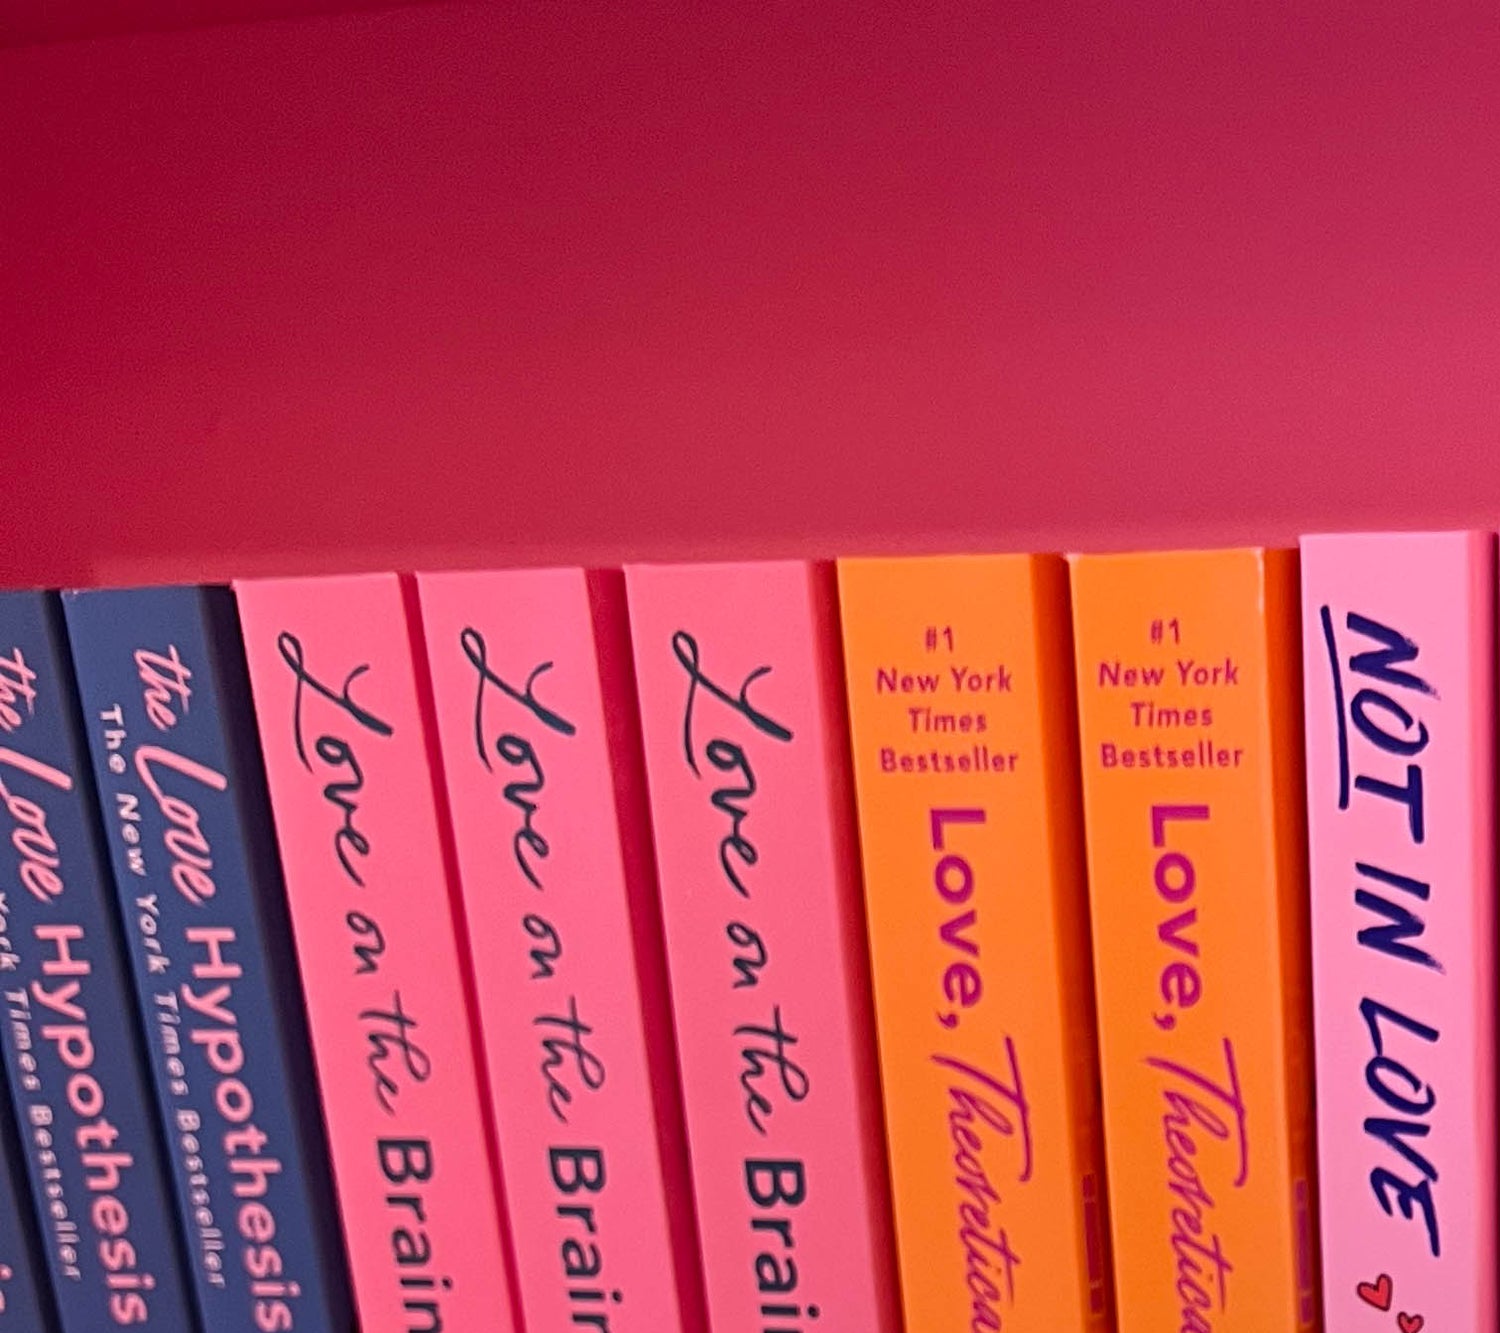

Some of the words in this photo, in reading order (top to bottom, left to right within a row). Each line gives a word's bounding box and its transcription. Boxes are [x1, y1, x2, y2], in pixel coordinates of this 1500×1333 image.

[134, 645, 191, 730] the
[876, 667, 940, 694] New
[950, 664, 1013, 694] York
[925, 625, 955, 653] #1
[1098, 661, 1165, 688] New
[1176, 658, 1239, 687] York
[1149, 618, 1181, 645] #1
[100, 703, 127, 774] The
[277, 630, 394, 888] Love
[460, 626, 577, 892] Love
[672, 629, 795, 900] Love
[880, 747, 1019, 774] Bestseller
[908, 707, 988, 734] Times
[1101, 741, 1244, 769] Bestseller
[1130, 700, 1214, 728] Times
[1346, 611, 1441, 845] NOT
[0, 746, 73, 902] Love
[116, 792, 147, 877] New
[135, 744, 228, 904] Love
[136, 894, 171, 974] York
[346, 910, 387, 976] on
[522, 913, 562, 979] on
[725, 921, 768, 991] on
[930, 808, 987, 1030] Love,
[1150, 804, 1211, 1031] Love,
[1354, 861, 1446, 976] IN
[153, 991, 189, 1096] Times
[358, 990, 434, 1118] the
[533, 995, 607, 1124] the
[732, 1003, 810, 1137] the
[5, 990, 41, 1092] Times
[29, 1105, 82, 1282] Bestseller
[30, 924, 156, 1326] Hypothesis
[180, 926, 301, 1333] Hypothesis
[1360, 996, 1441, 1259] LOVE
[176, 1108, 225, 1288] Bestseller
